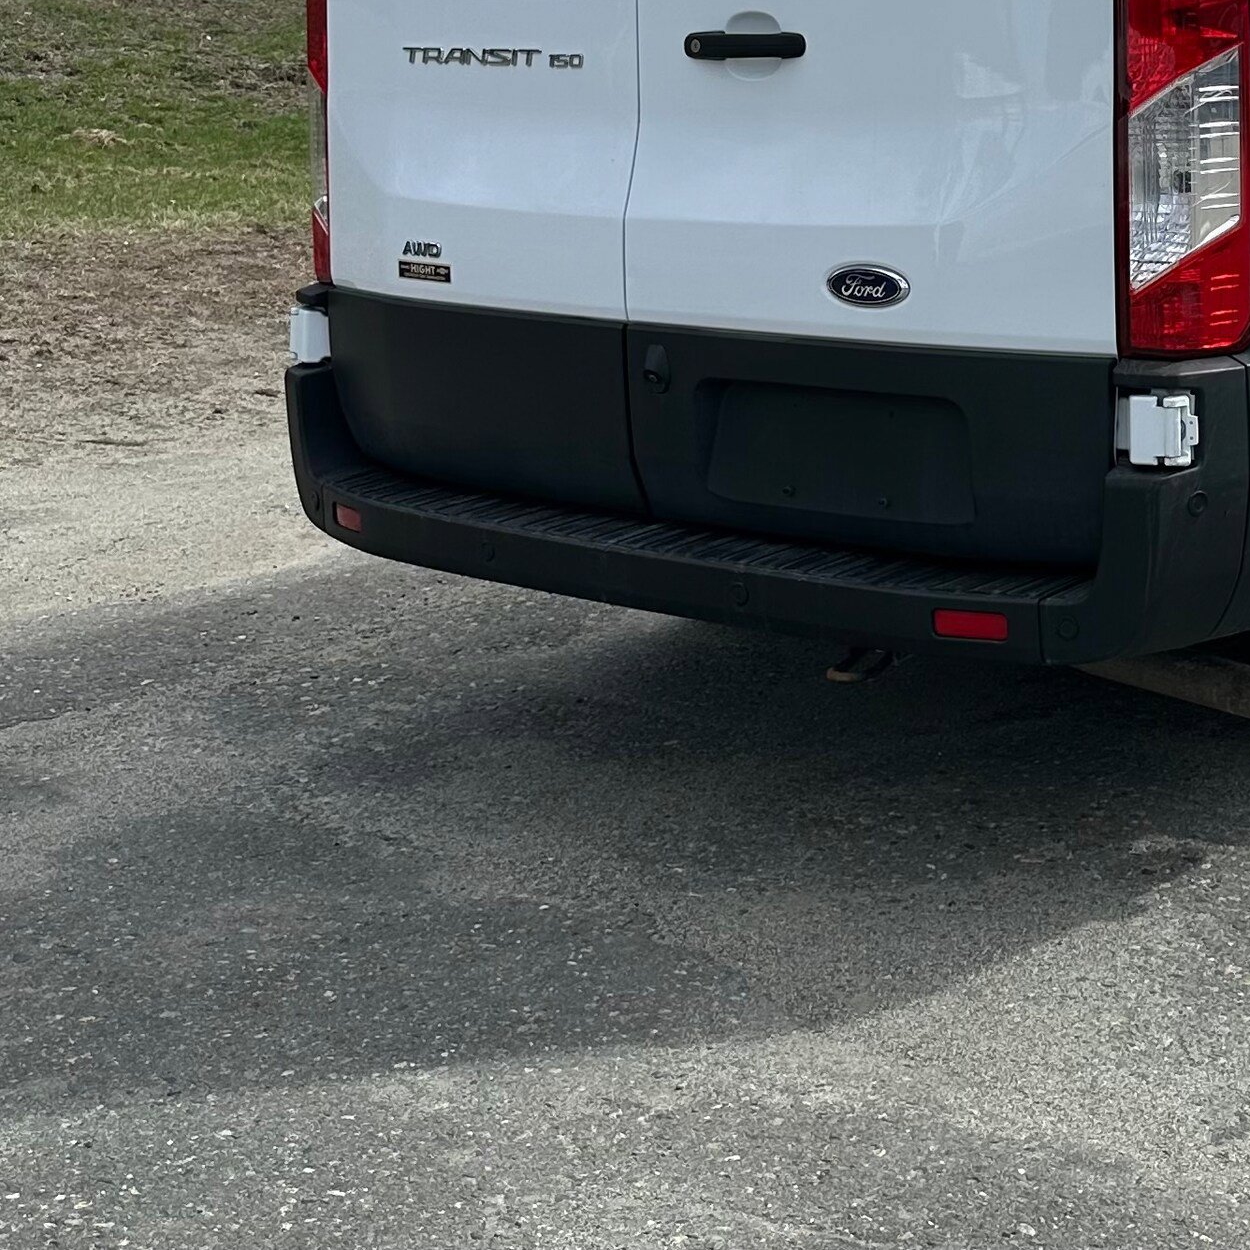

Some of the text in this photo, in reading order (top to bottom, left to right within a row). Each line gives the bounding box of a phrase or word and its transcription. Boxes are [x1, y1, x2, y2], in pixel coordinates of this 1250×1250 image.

[402, 46, 584, 69] TRANSIT 150
[402, 240, 442, 258] AWD
[841, 273, 887, 298] Ford
